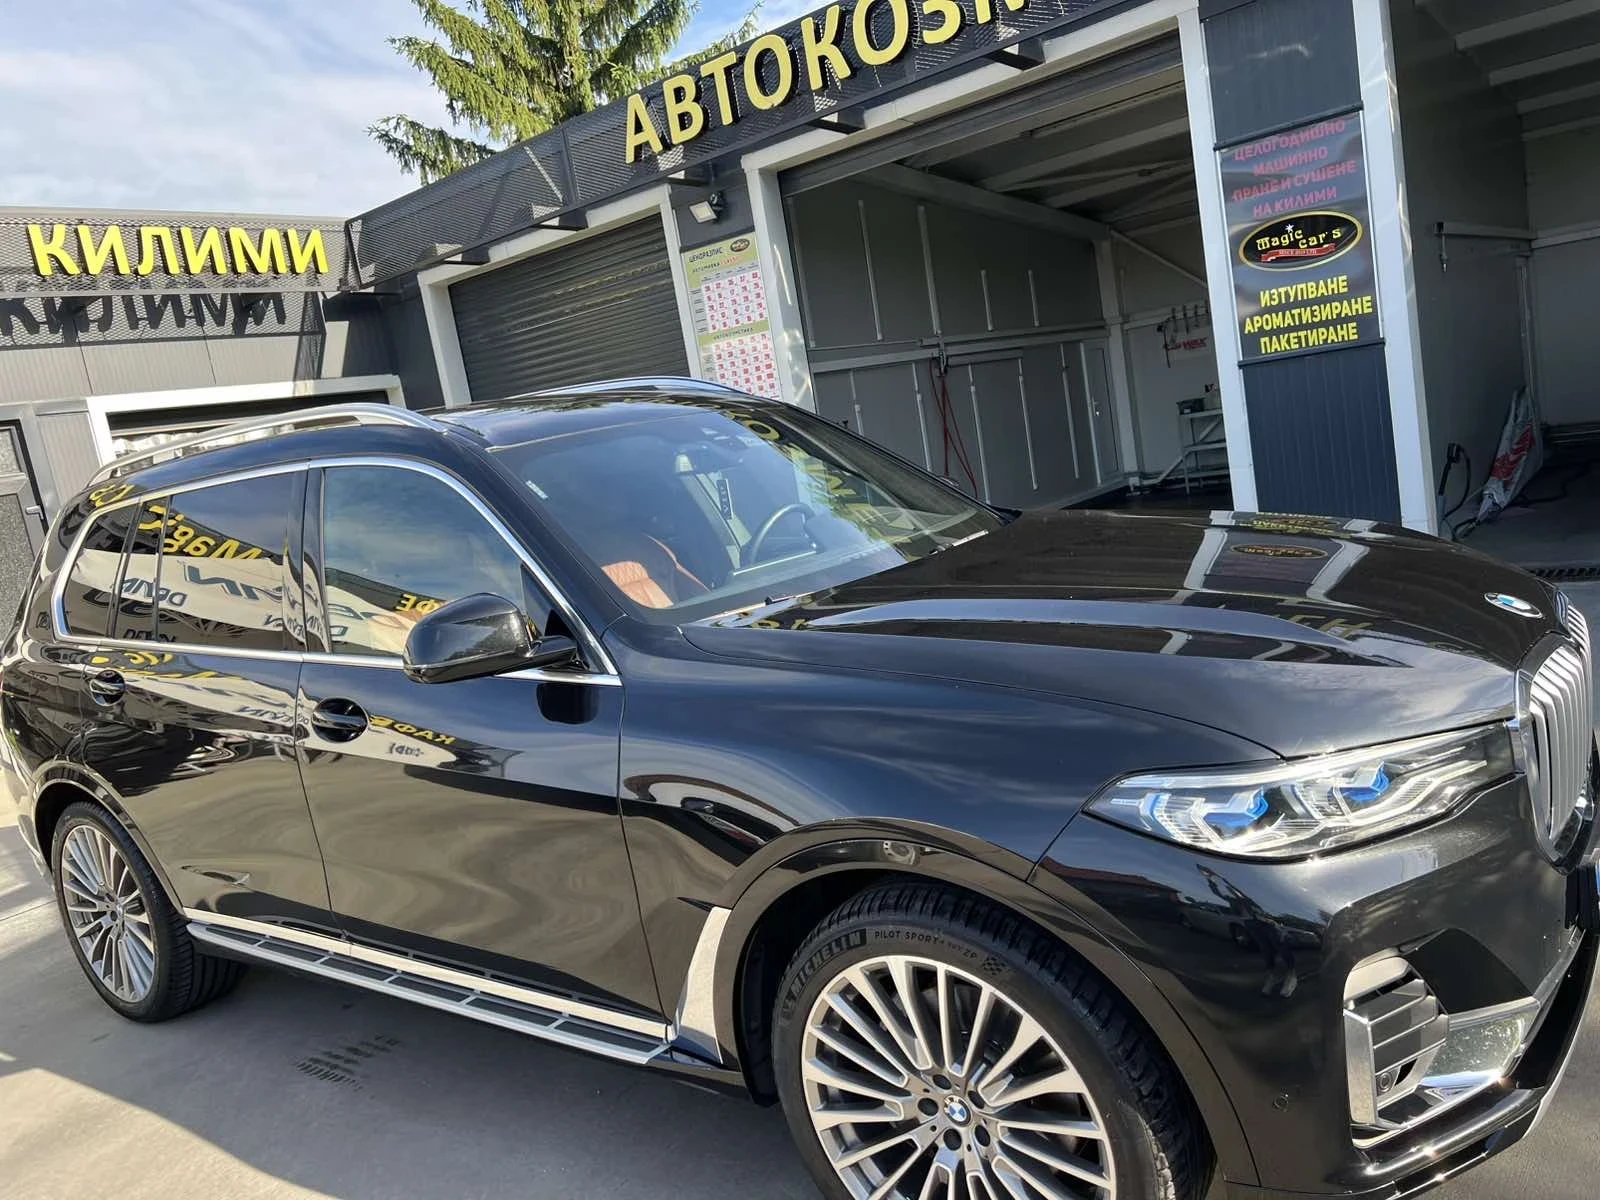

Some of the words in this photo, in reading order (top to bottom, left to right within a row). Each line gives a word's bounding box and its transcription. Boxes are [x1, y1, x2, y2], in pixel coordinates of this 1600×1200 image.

[1253, 147, 1328, 176] МАШИННО
[1294, 160, 1357, 187] СУШЕНЕ
[1253, 202, 1273, 218] НА
[1274, 186, 1337, 213] КИЛИМИ
[27, 224, 328, 276] КИЛИМИ
[1260, 275, 1349, 307] ИЗТУПВАНЕ
[1244, 295, 1374, 334] АРОМАТИЗИРАНЕ
[1260, 322, 1358, 354] ПАКЕТИРАНЕ
[875, 930, 900, 939] PILOT
[905, 931, 939, 944] SPORT
[790, 930, 861, 997] MICHELIN
